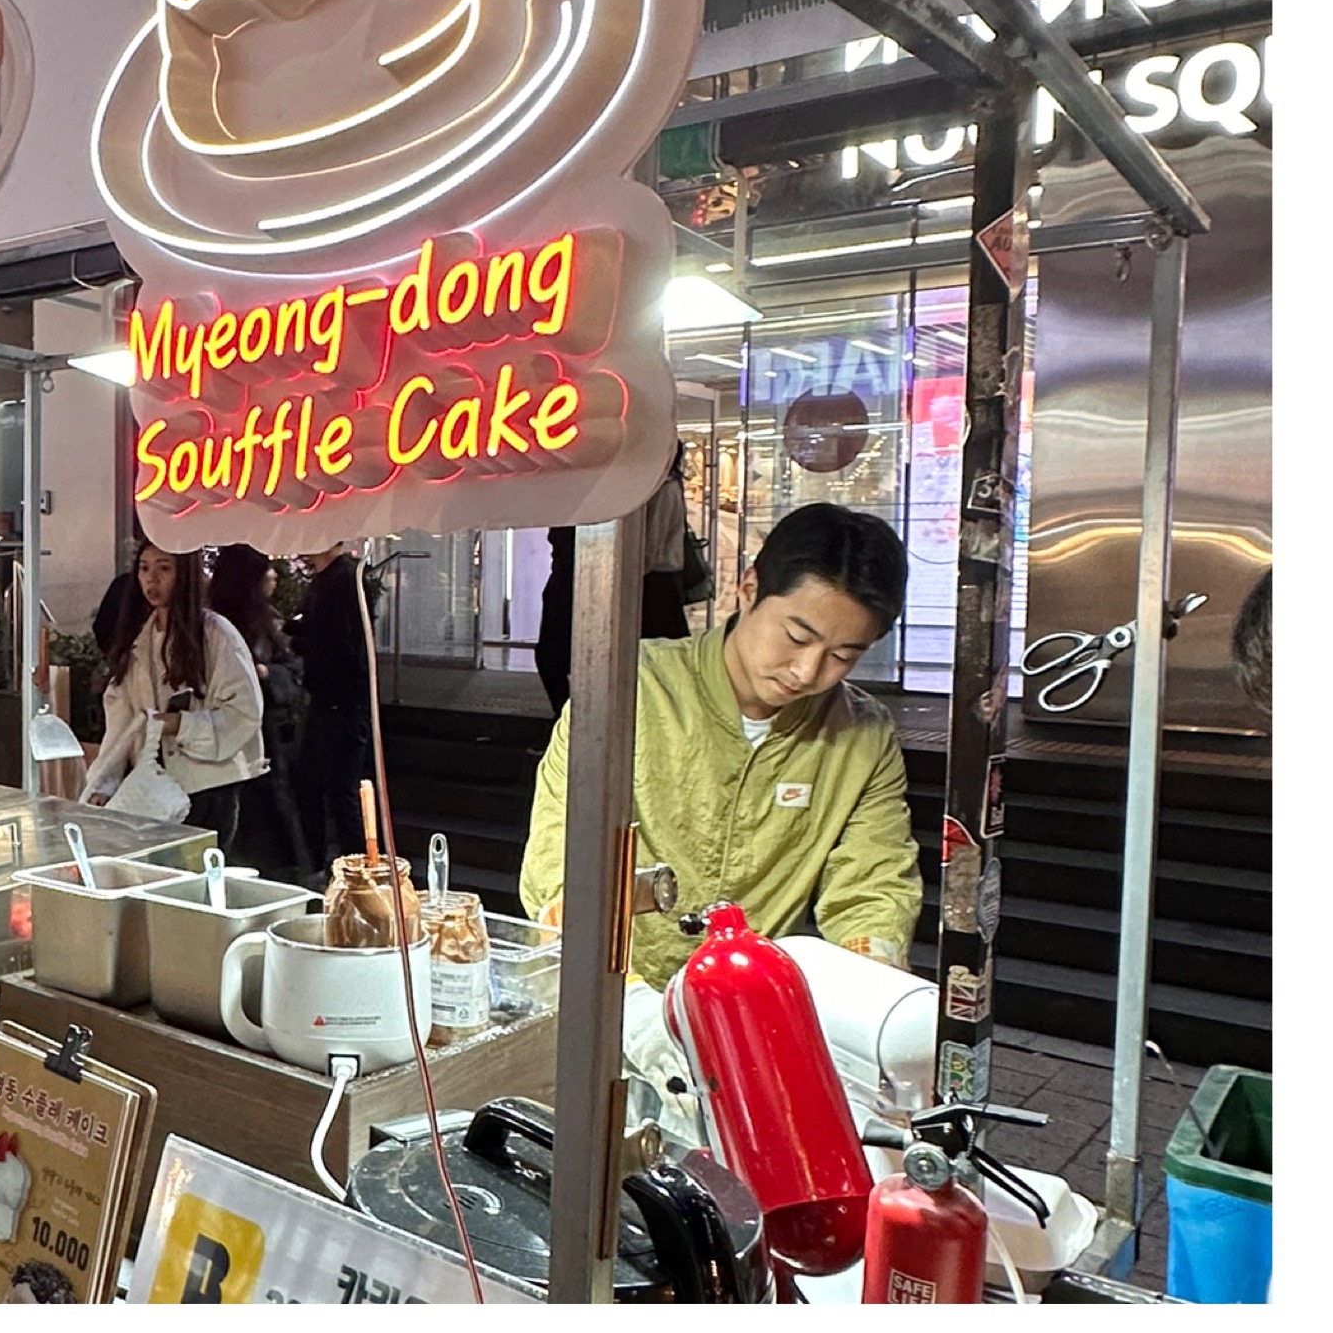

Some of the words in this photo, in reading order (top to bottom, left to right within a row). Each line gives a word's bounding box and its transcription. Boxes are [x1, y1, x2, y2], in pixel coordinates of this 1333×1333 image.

[130, 234, 574, 398] Myeong-dong
[135, 396, 354, 501] Souffle
[388, 364, 579, 465] Cake
[21, 1083, 62, 1120] 수플레
[65, 1105, 108, 1145] 케이크
[32, 1217, 89, 1271] 10.000
